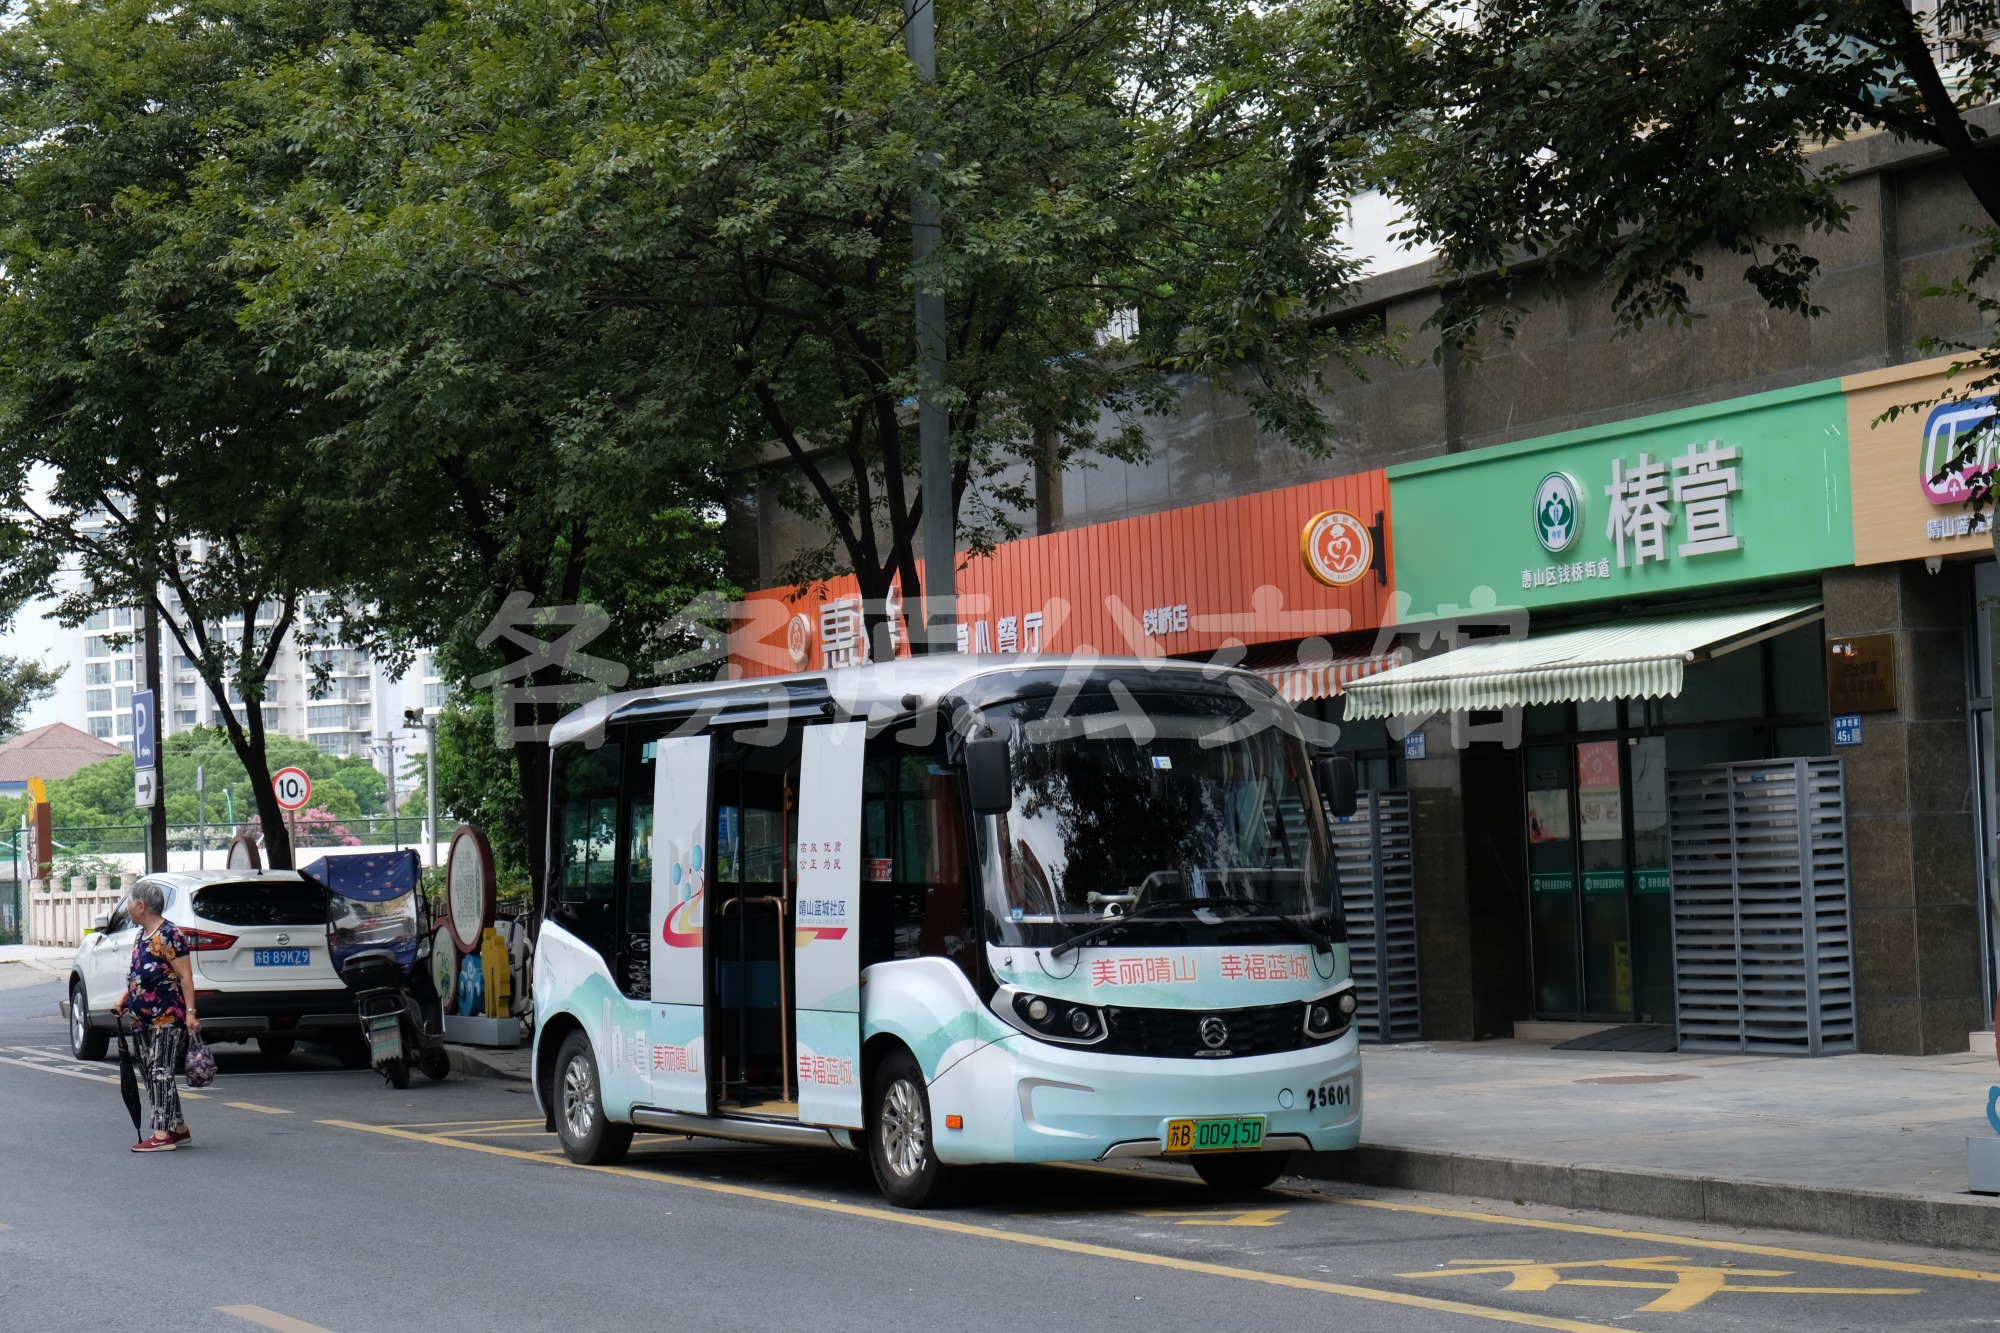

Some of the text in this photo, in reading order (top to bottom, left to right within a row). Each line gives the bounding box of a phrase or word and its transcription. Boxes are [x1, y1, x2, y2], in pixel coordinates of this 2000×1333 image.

[1604, 440, 1743, 568] 椿萱
[1521, 558, 1610, 589] 惠山区钱桥街道
[1143, 604, 1188, 636] 钱桥店
[135, 702, 147, 758] P
[799, 900, 846, 916] 晴山蓝城社区
[1091, 953, 1310, 987] 美丽晴山 幸福蓝城
[653, 1044, 853, 1086] 美丽晴山 幸福蓝城
[1307, 1084, 1351, 1113] 25601
